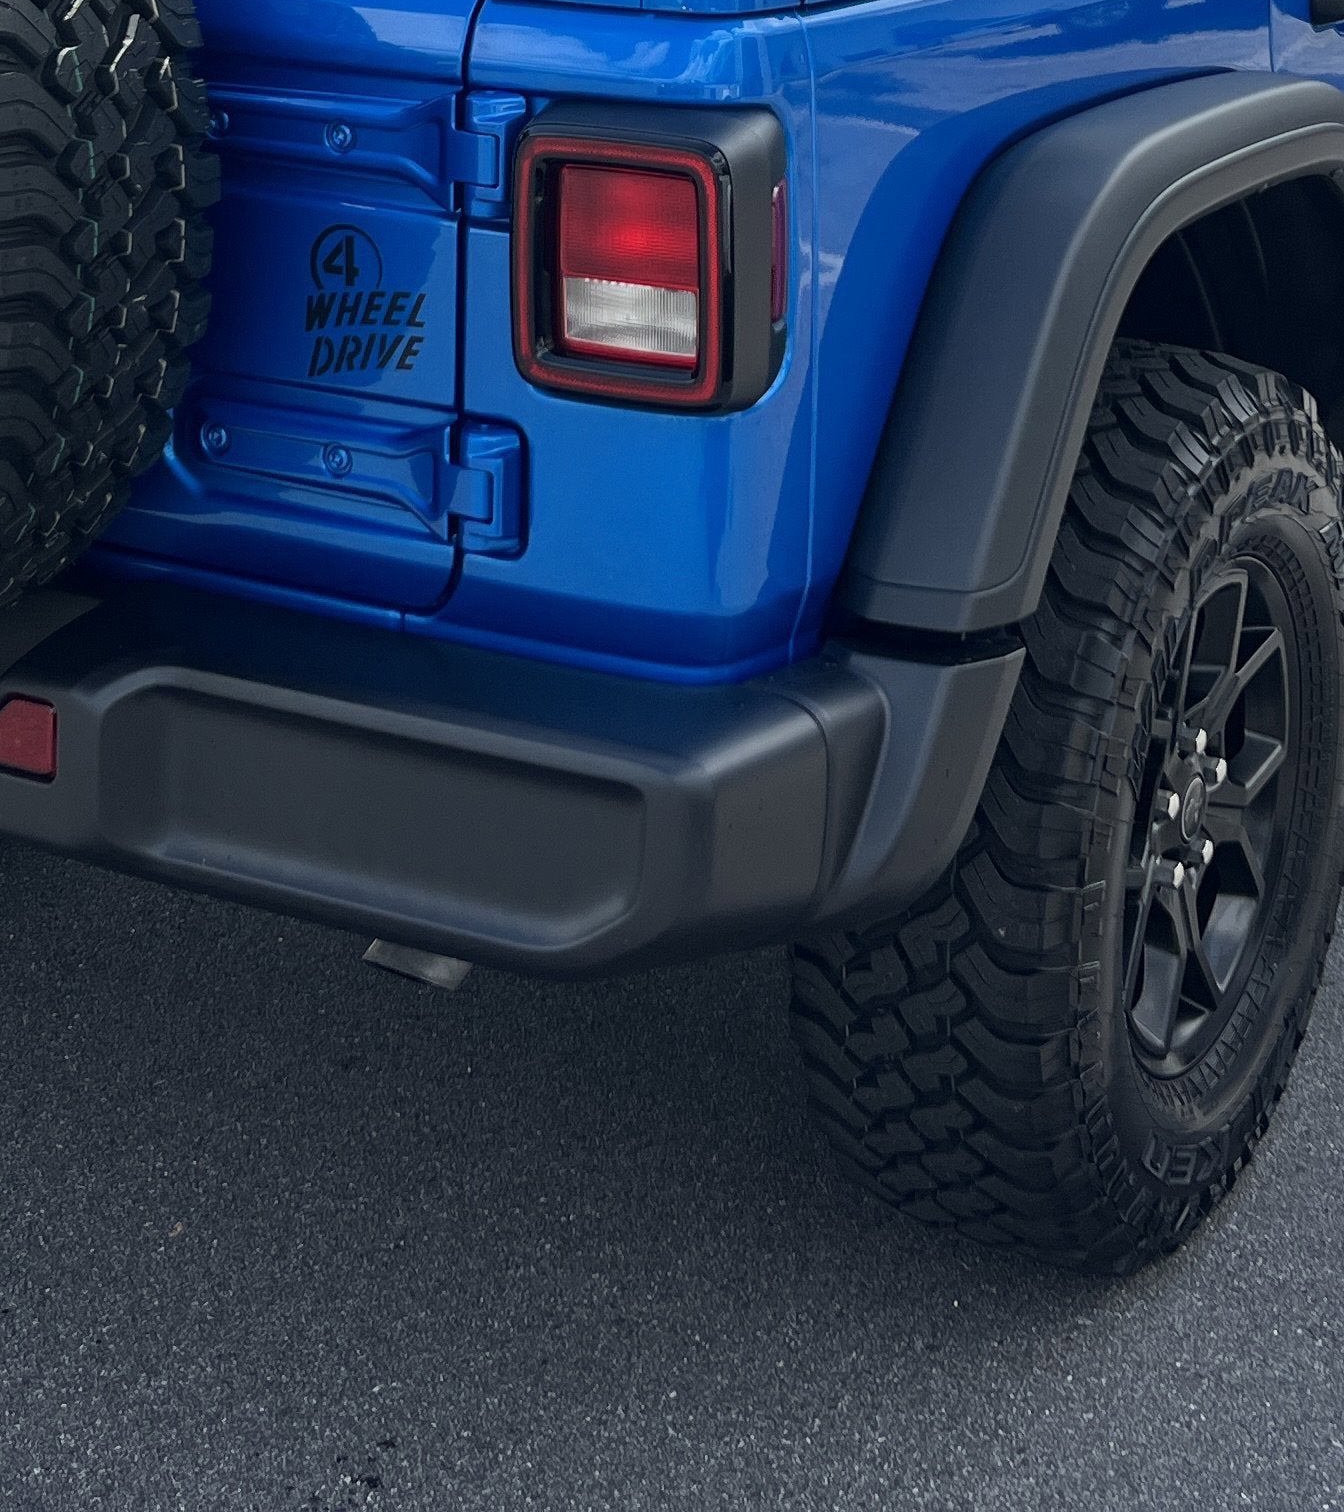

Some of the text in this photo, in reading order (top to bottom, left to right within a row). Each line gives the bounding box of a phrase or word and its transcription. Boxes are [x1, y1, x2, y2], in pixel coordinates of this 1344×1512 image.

[323, 236, 360, 287] 4
[305, 291, 427, 332] WHEEL
[307, 333, 425, 377] DRIVE
